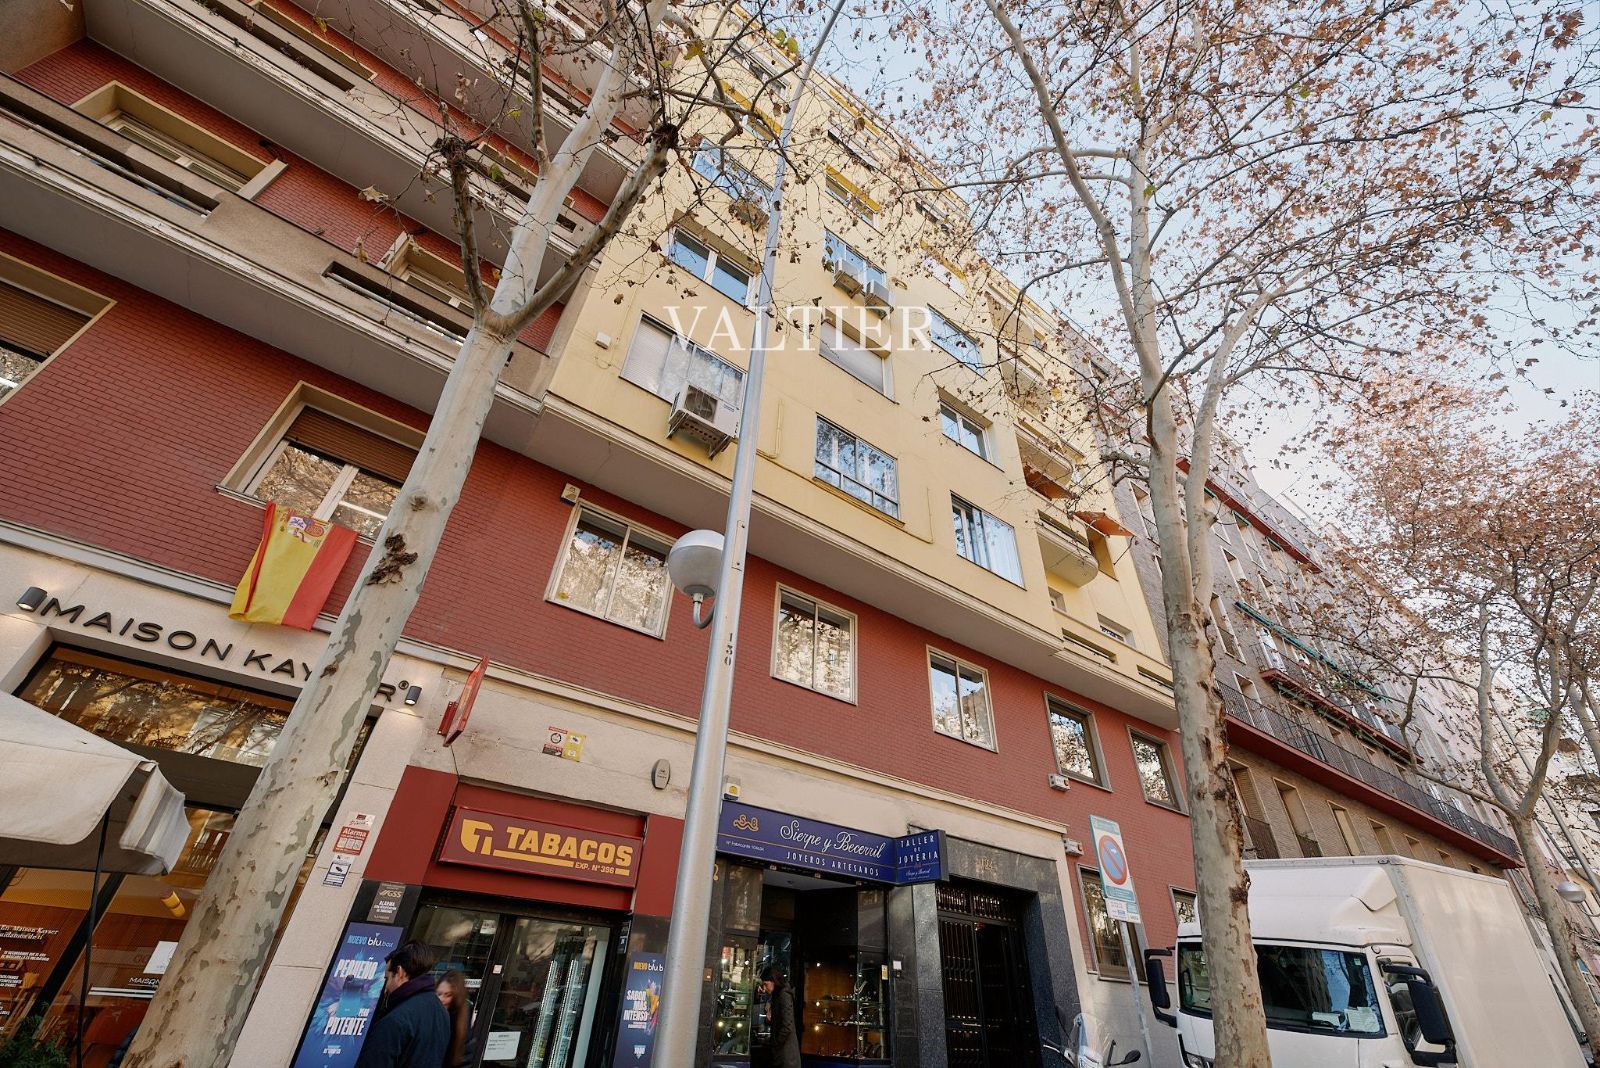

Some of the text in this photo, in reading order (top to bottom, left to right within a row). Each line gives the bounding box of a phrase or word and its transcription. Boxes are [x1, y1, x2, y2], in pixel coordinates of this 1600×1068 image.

[40, 597, 233, 661] MAISON
[506, 826, 634, 867] TABACOS
[780, 820, 822, 849] Sierpe
[823, 839, 834, 853] y
[900, 834, 934, 848] TALLER
[786, 852, 879, 877] JOYEROS ARTESANOS
[898, 851, 938, 864] JOYERIA
[334, 957, 379, 980] PEQUEÑO
[626, 990, 647, 1001] SABOR
[323, 1016, 367, 1036] POTENTE
[623, 1010, 648, 1021] INTENSO
